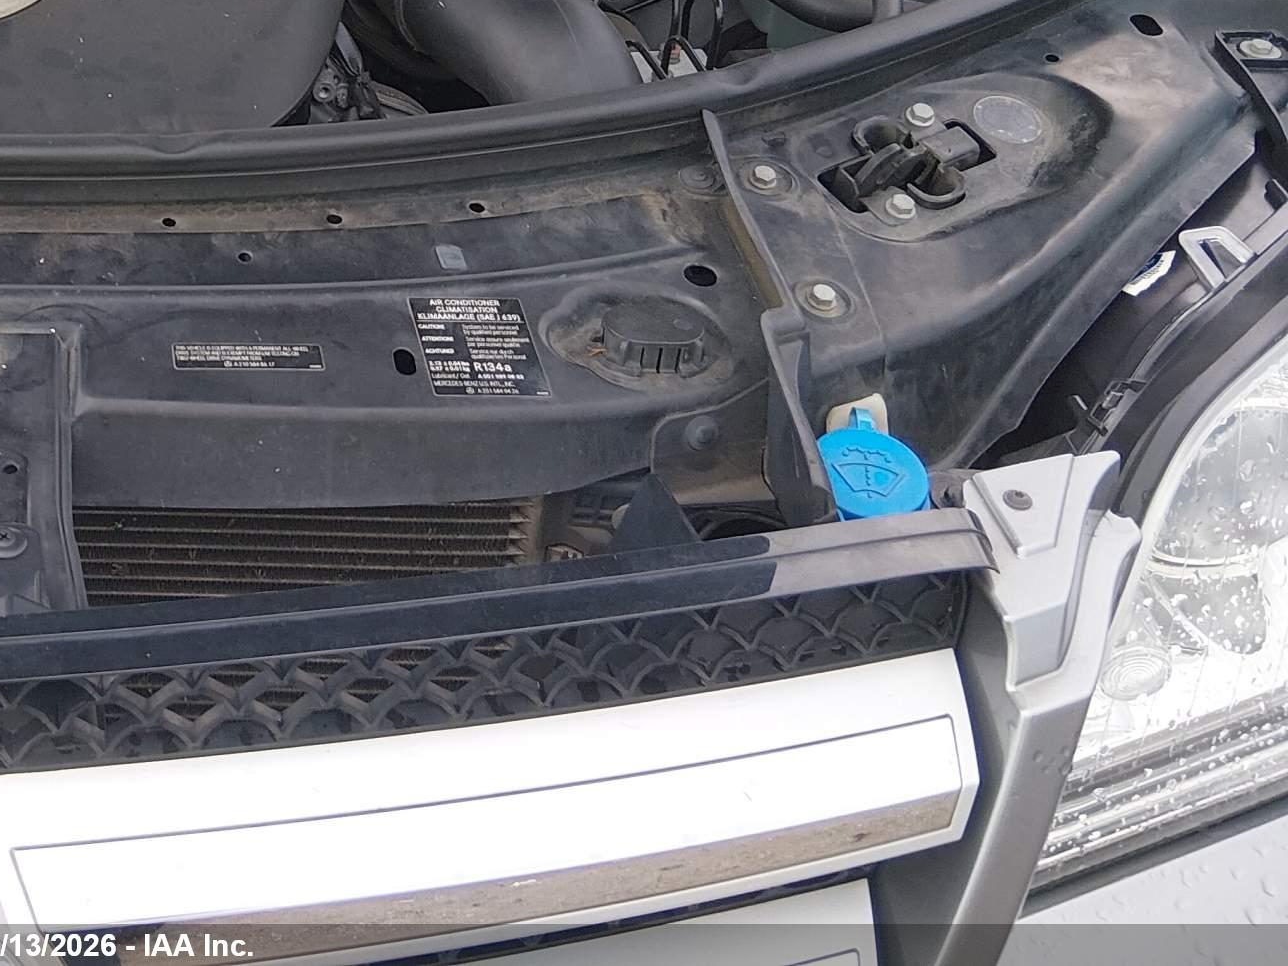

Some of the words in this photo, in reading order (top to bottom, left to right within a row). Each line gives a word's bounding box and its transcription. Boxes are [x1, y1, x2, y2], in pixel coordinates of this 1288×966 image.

[429, 299, 443, 307] AIR
[444, 299, 500, 307] CONDITIONER
[435, 306, 498, 314] CLIMATISATION
[416, 313, 475, 321] KLIMAANLAGE
[476, 313, 495, 322] (SAE
[501, 314, 521, 322] 639)
[473, 361, 513, 372] R134a
